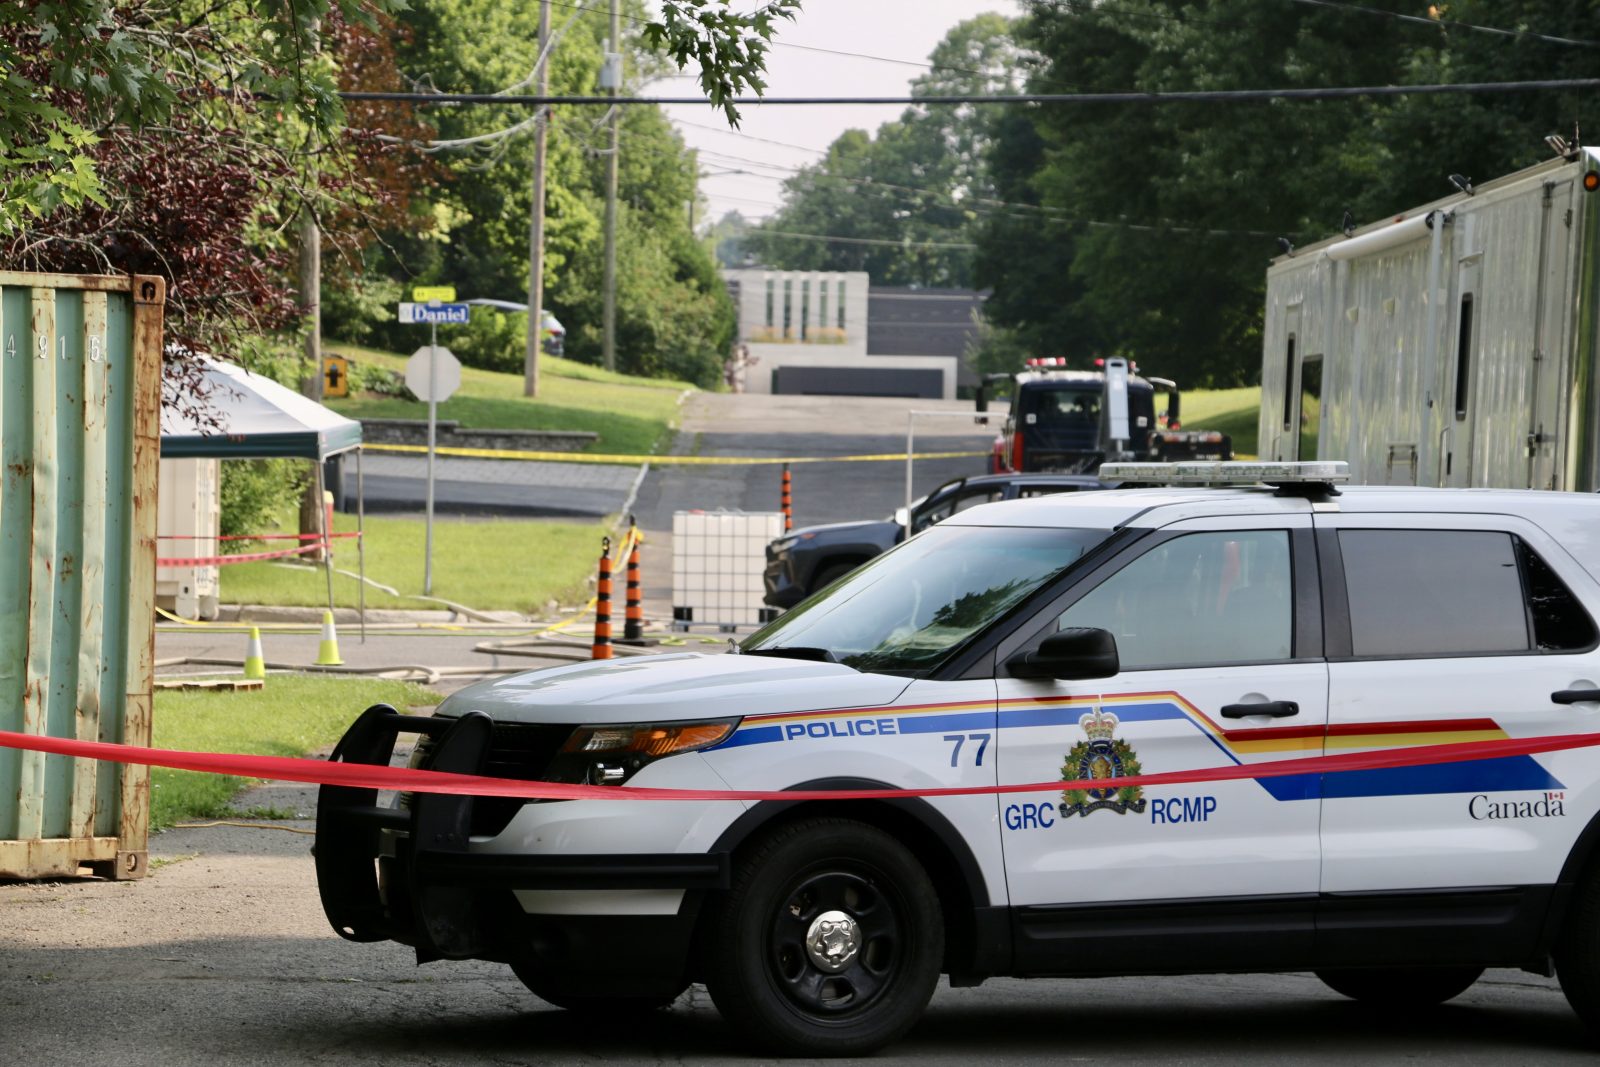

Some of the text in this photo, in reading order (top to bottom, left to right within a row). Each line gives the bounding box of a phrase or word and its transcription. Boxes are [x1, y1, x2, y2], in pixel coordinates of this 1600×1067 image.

[414, 305, 466, 322] Daniel
[786, 718, 897, 741] POLICE
[943, 733, 991, 768] 77
[1005, 802, 1055, 831] GRC
[1151, 796, 1217, 825] RCMP
[1468, 792, 1565, 821] Canada
